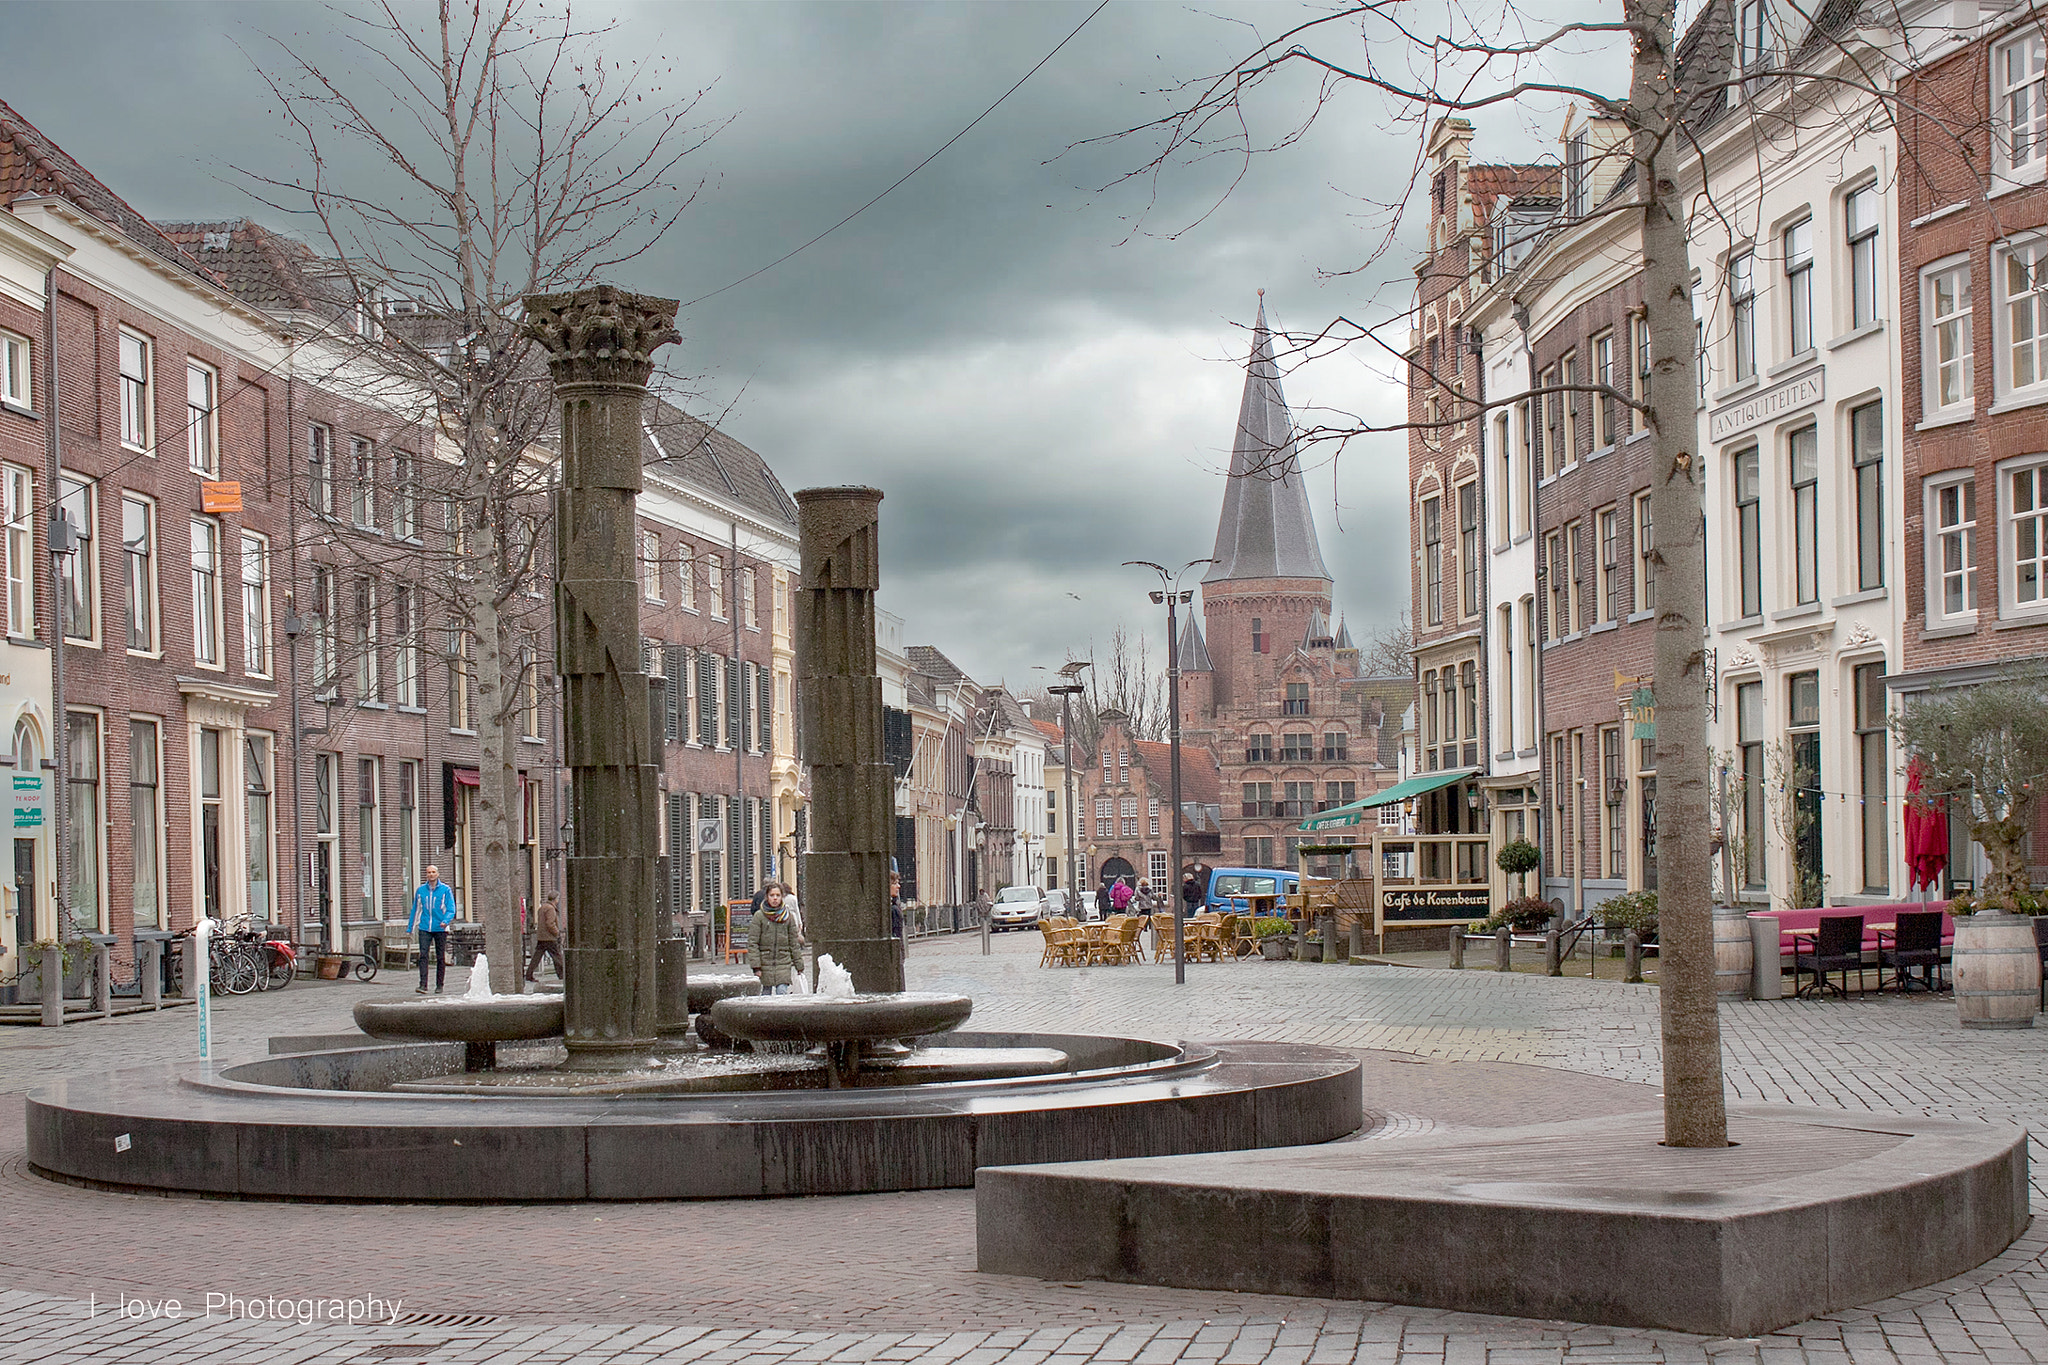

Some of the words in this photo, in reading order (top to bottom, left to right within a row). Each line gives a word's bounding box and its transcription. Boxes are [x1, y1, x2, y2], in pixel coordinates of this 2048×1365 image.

[1716, 377, 1817, 434] ANTIQUITEITEN
[1413, 892, 1425, 906] de
[1426, 891, 1489, 906] Korenbeurs
[199, 984, 207, 1055] DRINKWATER
